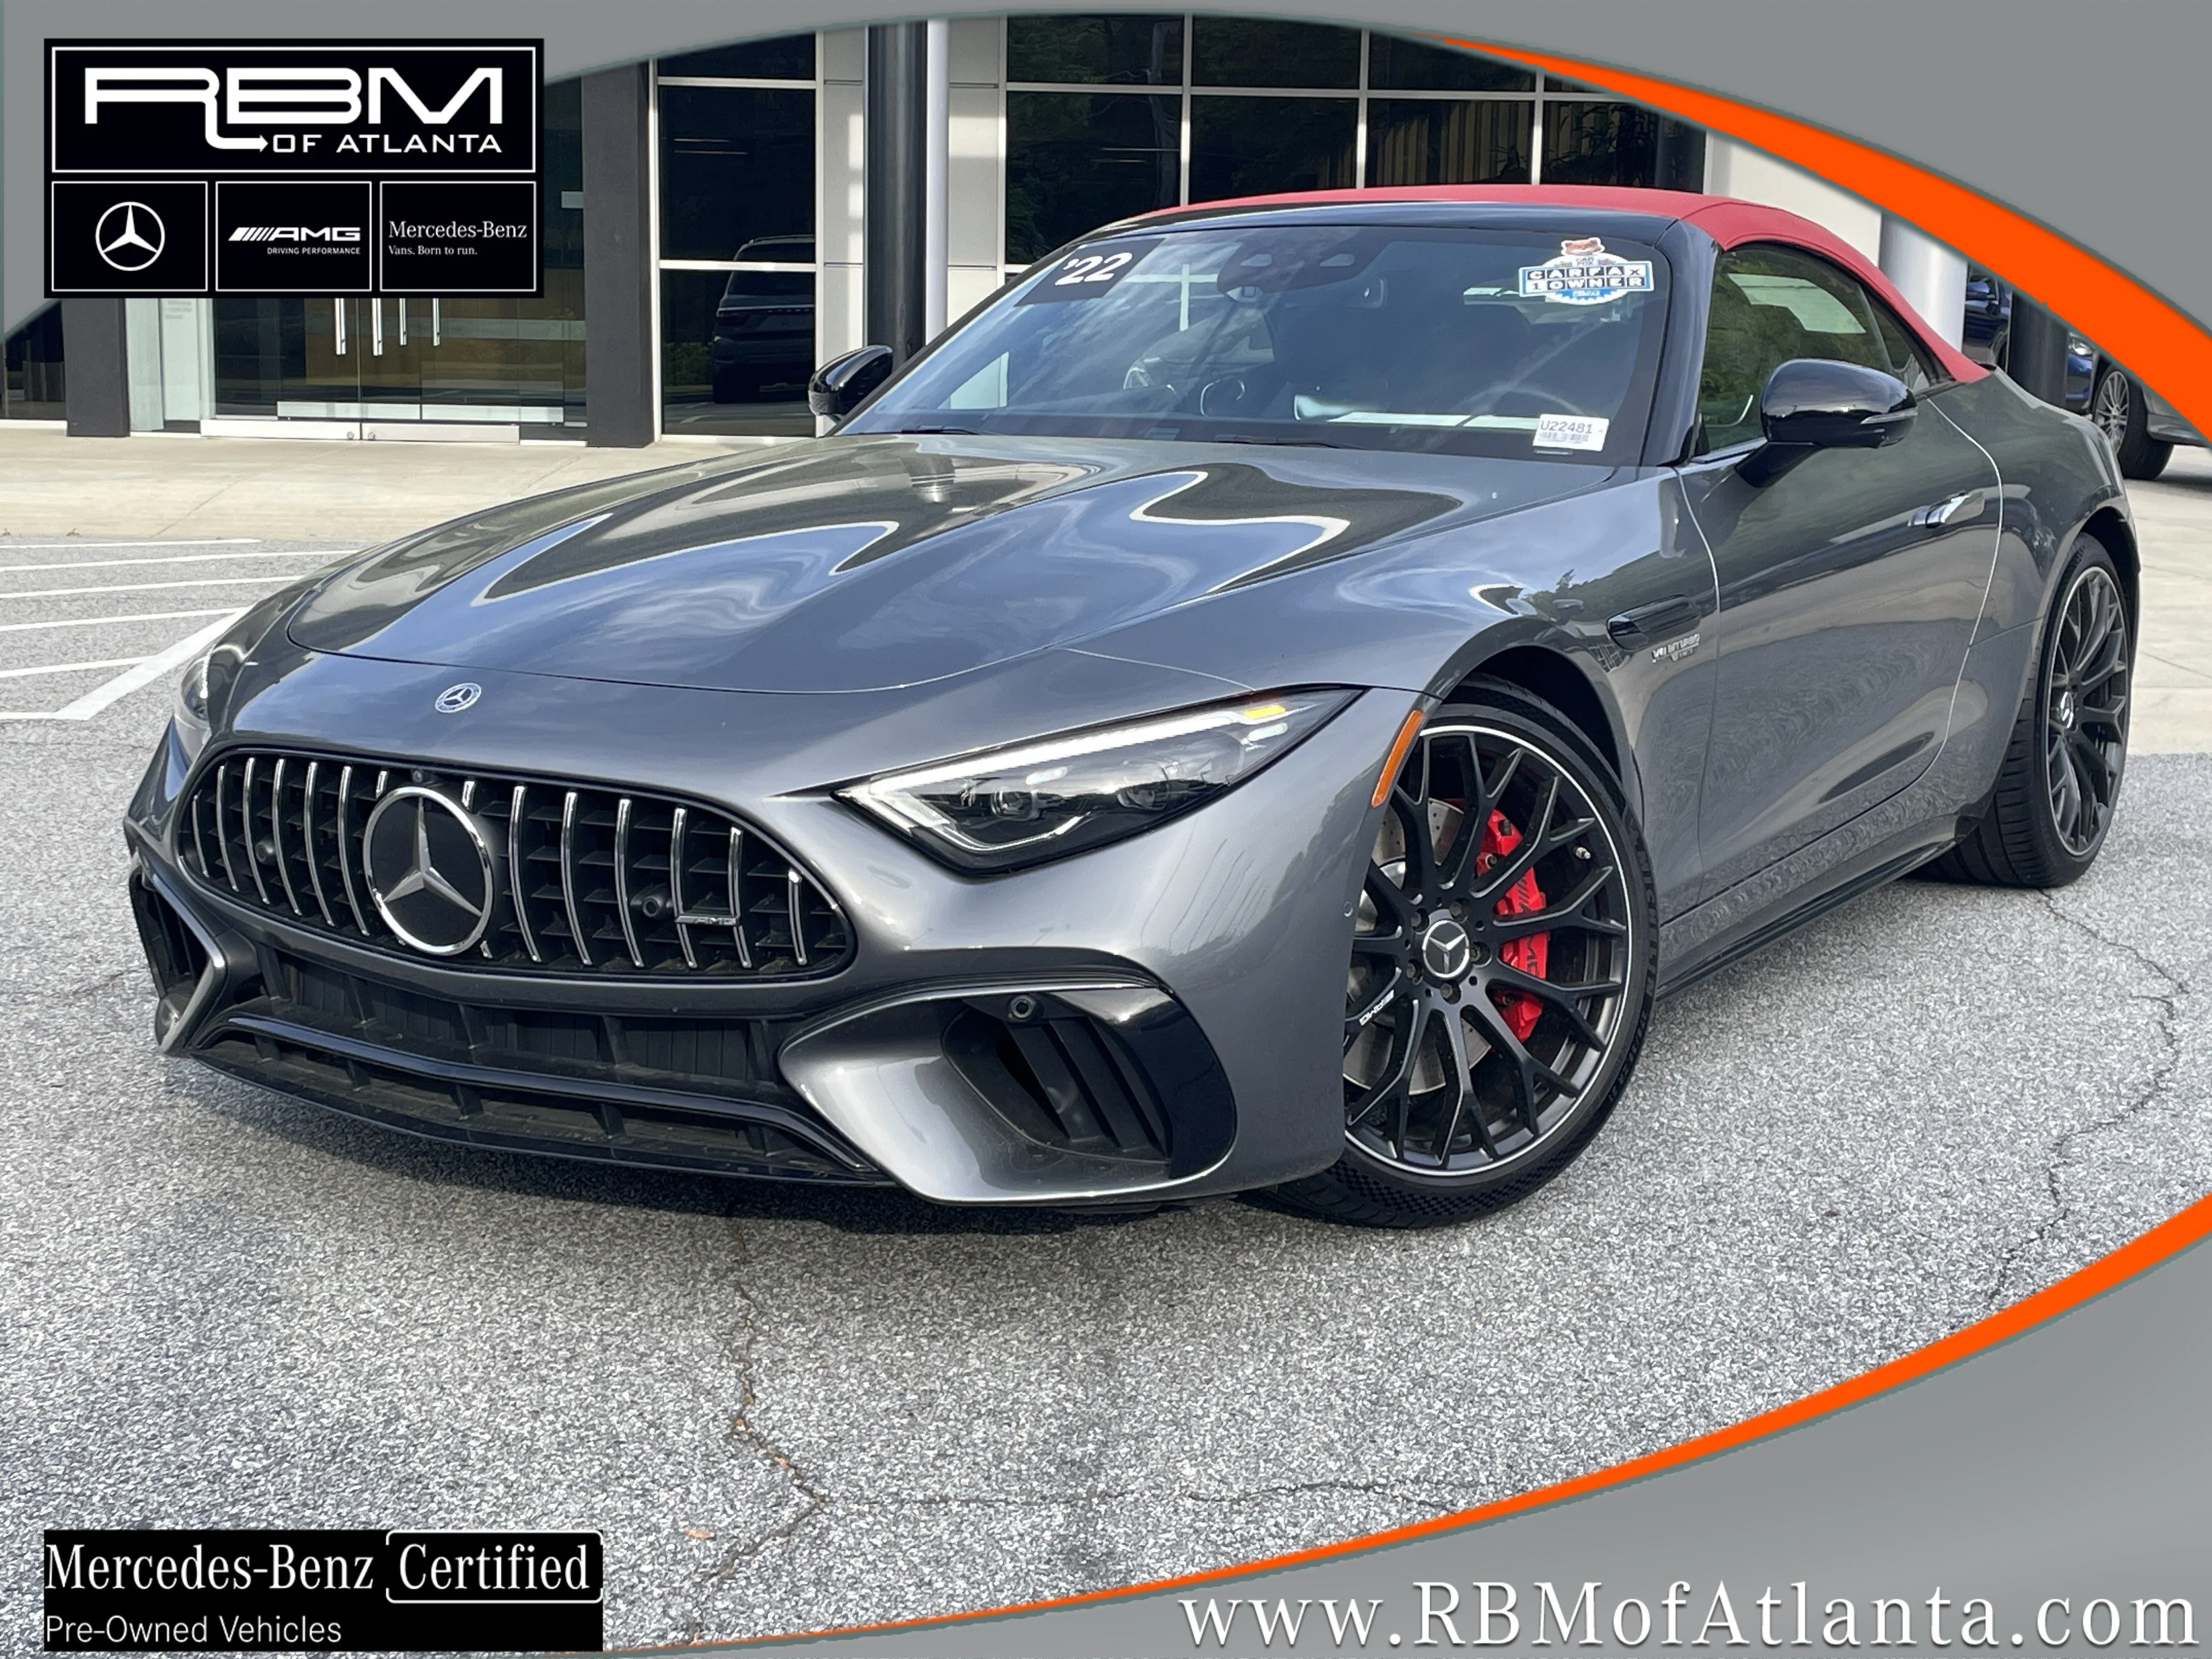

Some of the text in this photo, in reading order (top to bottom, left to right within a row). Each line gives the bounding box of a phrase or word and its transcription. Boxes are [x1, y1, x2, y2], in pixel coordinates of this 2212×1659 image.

[1055, 252, 1133, 286] '22
[1528, 266, 1642, 280] CARFAX
[1532, 277, 1643, 291] 1 OWNER
[1541, 420, 1592, 434] U22481
